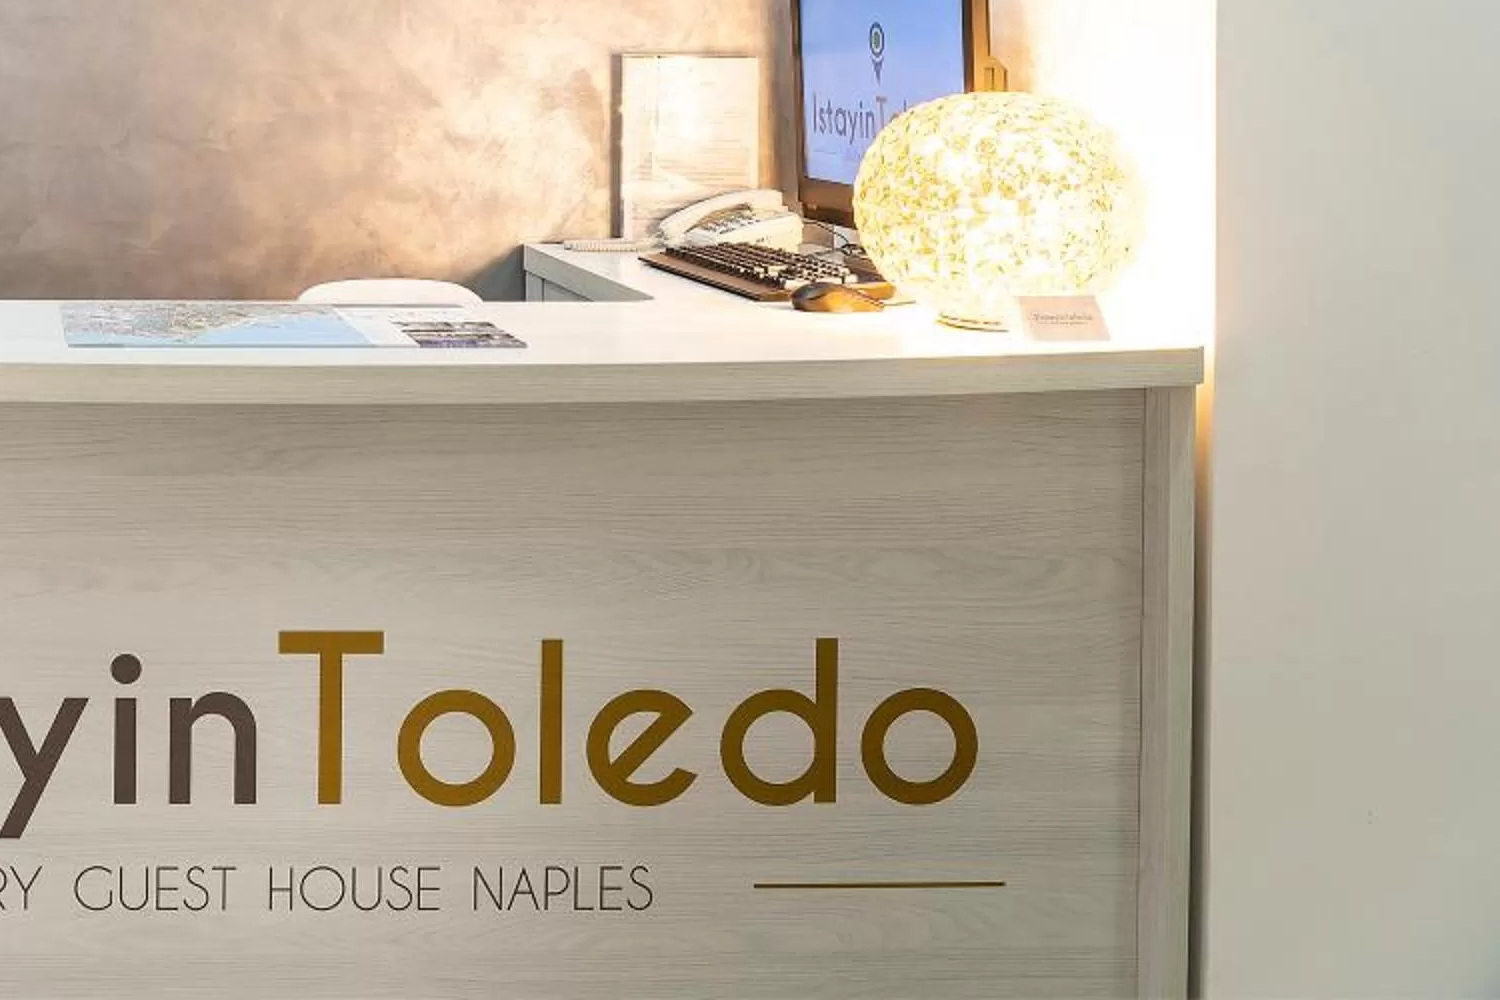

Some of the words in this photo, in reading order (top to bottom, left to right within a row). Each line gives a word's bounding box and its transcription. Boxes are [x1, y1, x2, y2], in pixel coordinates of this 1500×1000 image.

[73, 864, 237, 913] GUEST
[268, 865, 441, 913] HOUSE
[471, 865, 655, 912] NAPLES
